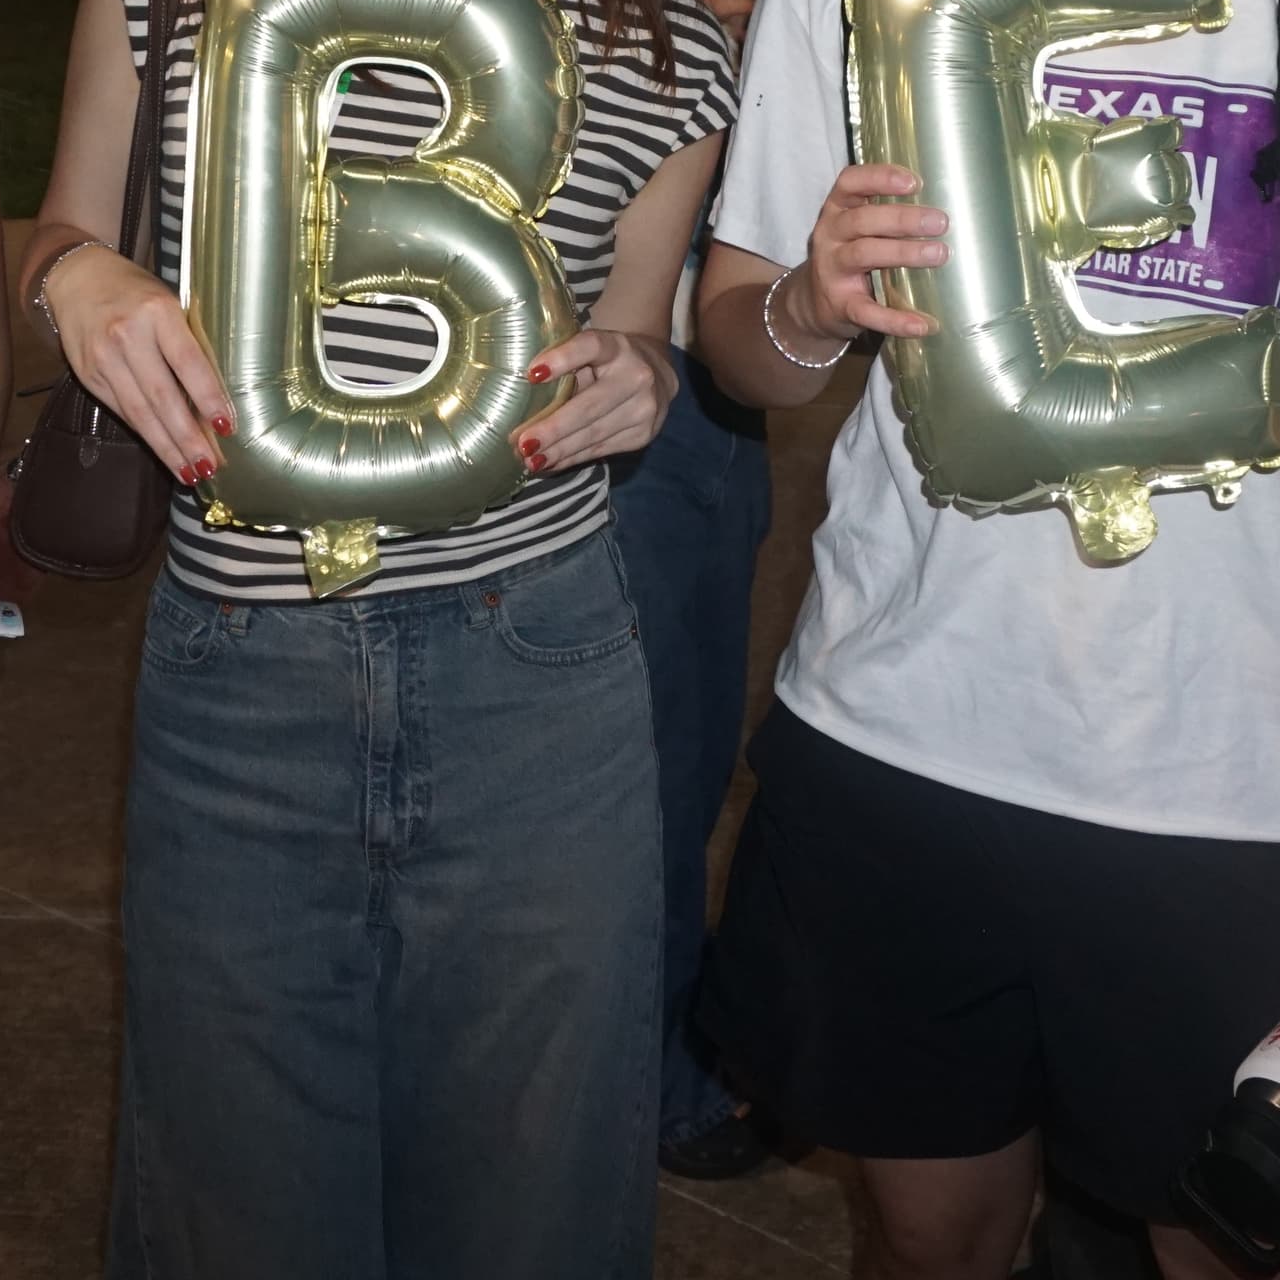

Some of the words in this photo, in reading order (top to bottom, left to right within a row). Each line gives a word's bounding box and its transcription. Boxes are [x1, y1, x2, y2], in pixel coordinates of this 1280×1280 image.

[1043, 83, 1205, 128] EXAS
[1080, 250, 1132, 276] TAR
[1137, 254, 1204, 287] STATE
